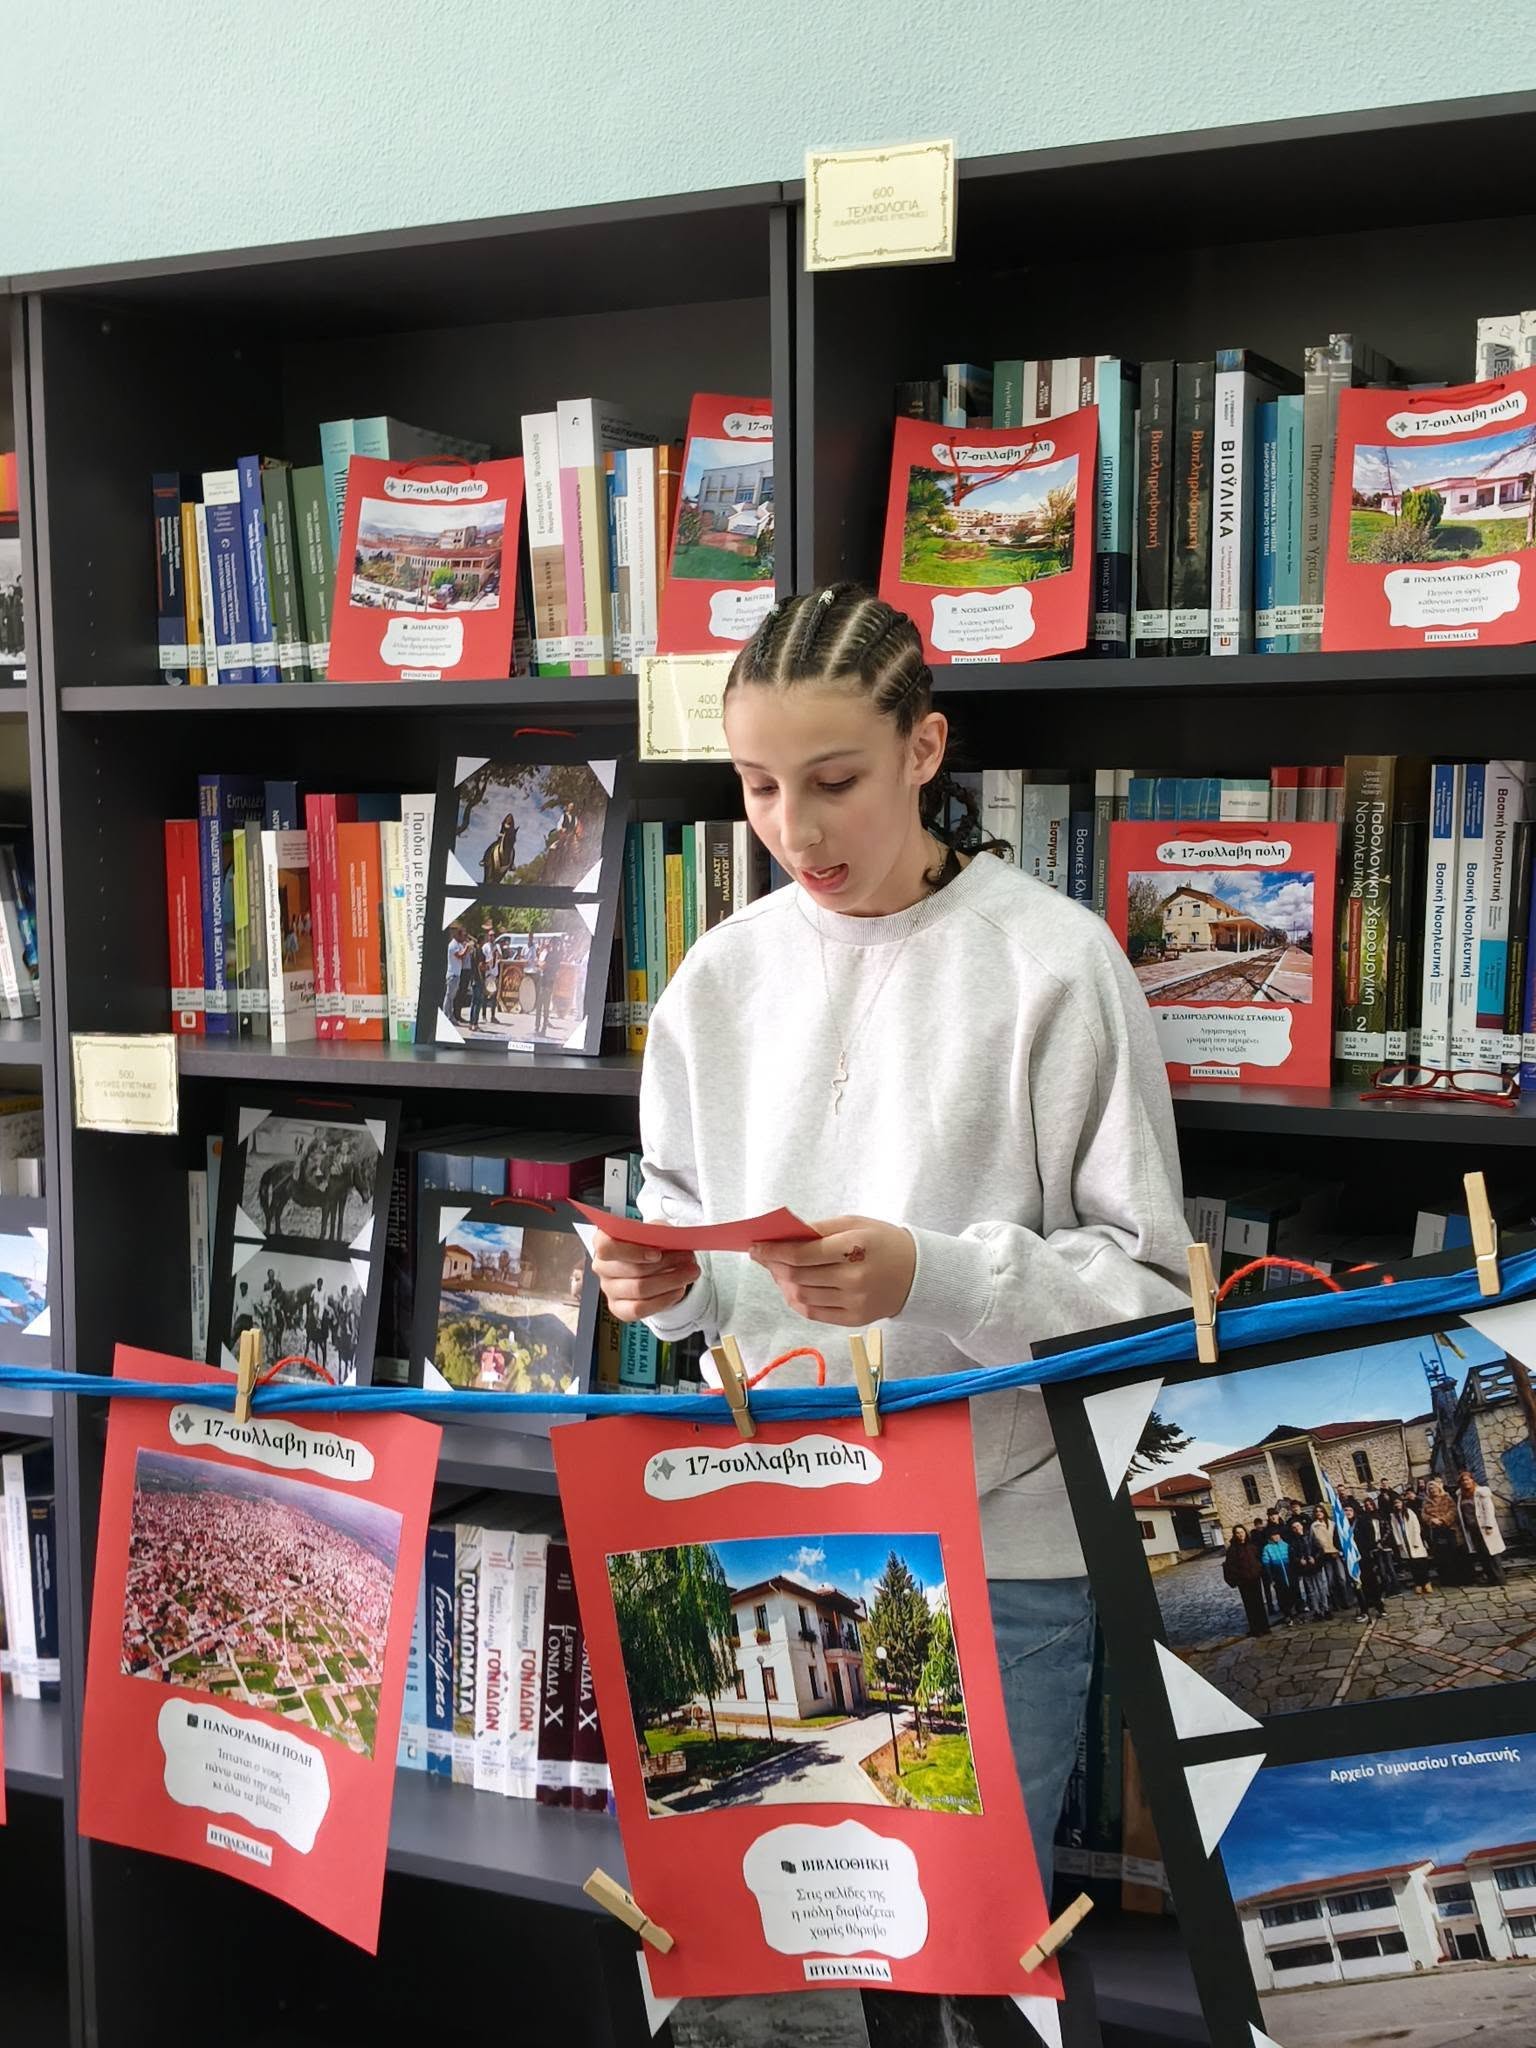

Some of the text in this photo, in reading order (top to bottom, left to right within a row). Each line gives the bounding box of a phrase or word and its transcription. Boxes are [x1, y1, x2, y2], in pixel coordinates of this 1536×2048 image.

[848, 199, 919, 219] ΤΕΧΝΟΛΟΓΙΑ
[872, 186, 894, 200] 600
[1414, 397, 1520, 431] 17-συλλαβη πόλη
[956, 448, 1020, 462] 17-συλλαβη
[1102, 455, 1114, 540] ΙΑΤΡΙΚΗ ΦΥΣΙΚΗ
[1146, 430, 1163, 549] Βιοπληροφορική
[1186, 430, 1204, 550] Βιοπληροφορική
[1219, 440, 1237, 539] ΒΙΟΫΛΙΚΑ
[1475, 568, 1508, 579] ΚΕΝΤΡΟ
[960, 604, 1015, 614] ΝΟΣΟΚΟΜΕΙΟ
[697, 694, 717, 705] 400
[1046, 820, 1061, 868] Εισαγωγή
[1075, 828, 1089, 875] Βασικές
[1182, 844, 1285, 860] 17-συλλαβη πόλη
[1490, 788, 1508, 902] Βασική Νοσηλευτική
[1430, 862, 1447, 978] Βασική Νοσηλευτική
[1461, 862, 1478, 978] Βασική Νοσηλευτική
[1246, 1014, 1287, 1022] ΣΤΑΘΜΟΣ
[1356, 1016, 1367, 1031] 2
[638, 1354, 648, 1373] ΚΑΙ
[204, 1418, 355, 1468] 17-συλλαβη πόλη
[685, 1443, 867, 1476] 17-συλλαβη πόλη
[459, 1570, 477, 1714] ΓΟΝΙΔΙΩΜΑΤΑ
[485, 1647, 501, 1731] ΓΟΝΙΔΙΩΝ
[519, 1648, 537, 1731] ΓΟΝΙΔΙΩΝ
[544, 1622, 564, 1728] ΓΟΝΙΔΙΑ X
[577, 1638, 597, 1731] ΝΙΔΙΑ X
[203, 1719, 313, 1769] ΠΑΝΟΡΑΜΙΚΗ ΠΟΛΗ
[1329, 1745, 1522, 1784] Αρχείο Γυμνασίου Γαλατινής
[205, 1762, 290, 1805] πάνω από την πόλη
[224, 1782, 242, 1799] όλα
[244, 1792, 254, 1803] τα
[210, 1829, 270, 1860] ΠΤΟΛΕΜΑΪΔΑ
[801, 1858, 890, 1872] ΒΙΒΛΙΟΘΗΚΗ
[796, 1885, 886, 1903] Στις σελίδες της
[791, 1904, 896, 1923] η πόλη διαβάζεται
[809, 1922, 887, 1941] χωρίς θόρυβο
[809, 1963, 890, 1979] ΠΤΟΛΕΜΑΪΔΑ
